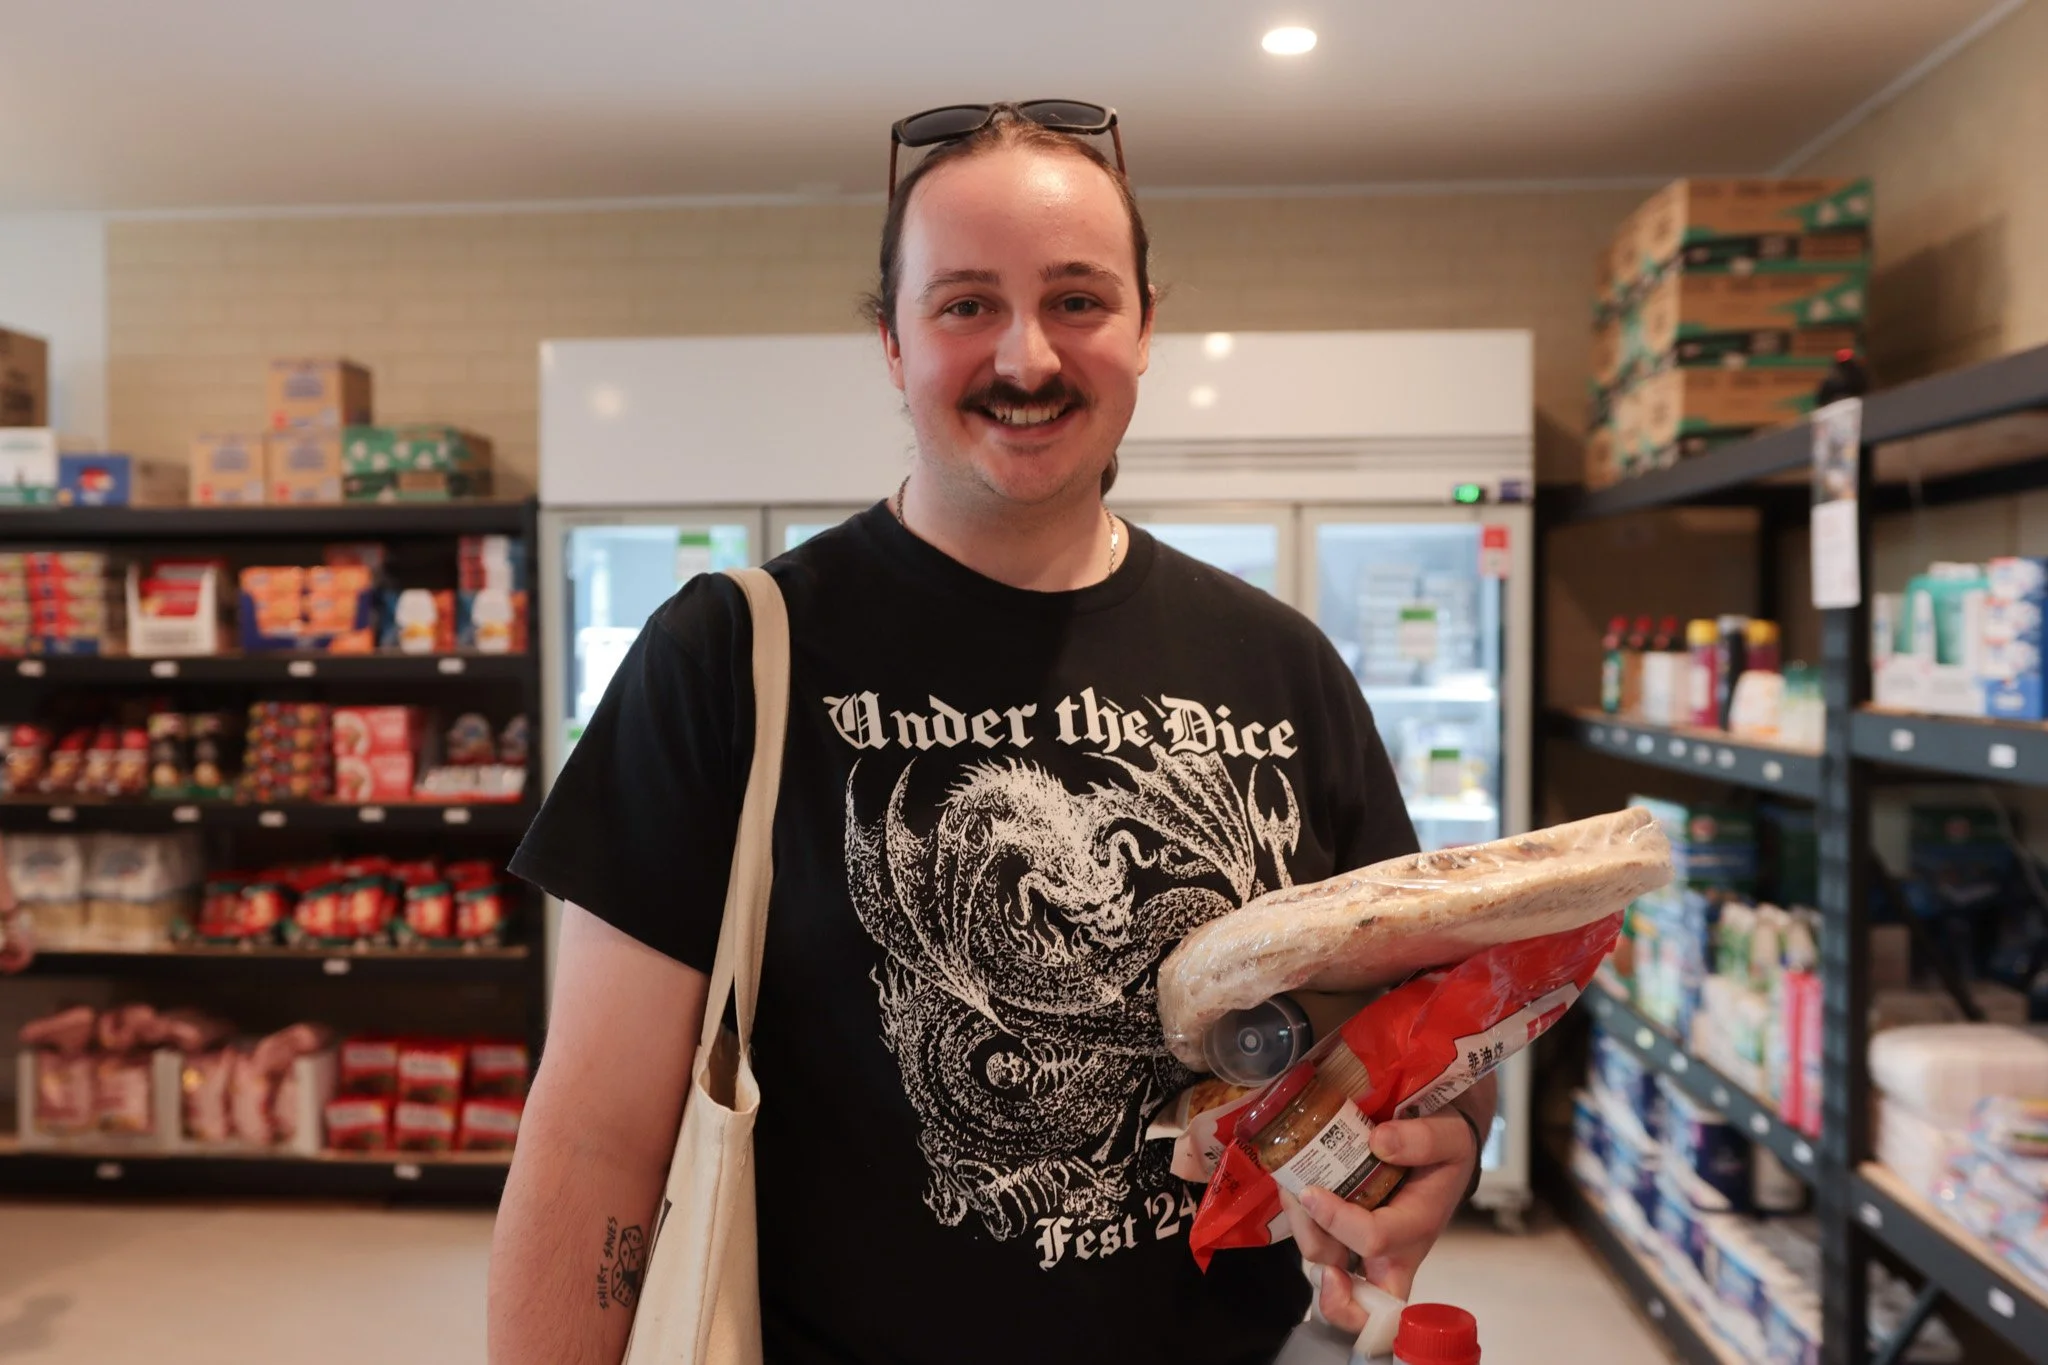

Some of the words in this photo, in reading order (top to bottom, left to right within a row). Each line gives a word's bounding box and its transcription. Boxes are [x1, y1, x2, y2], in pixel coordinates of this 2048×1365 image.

[822, 690, 1038, 751] Under
[1054, 686, 1154, 754] the
[1160, 693, 1298, 760] Dice
[1467, 1041, 1504, 1070] 非油炸
[1034, 1215, 1140, 1272] Fest
[1144, 1183, 1198, 1241] '24
